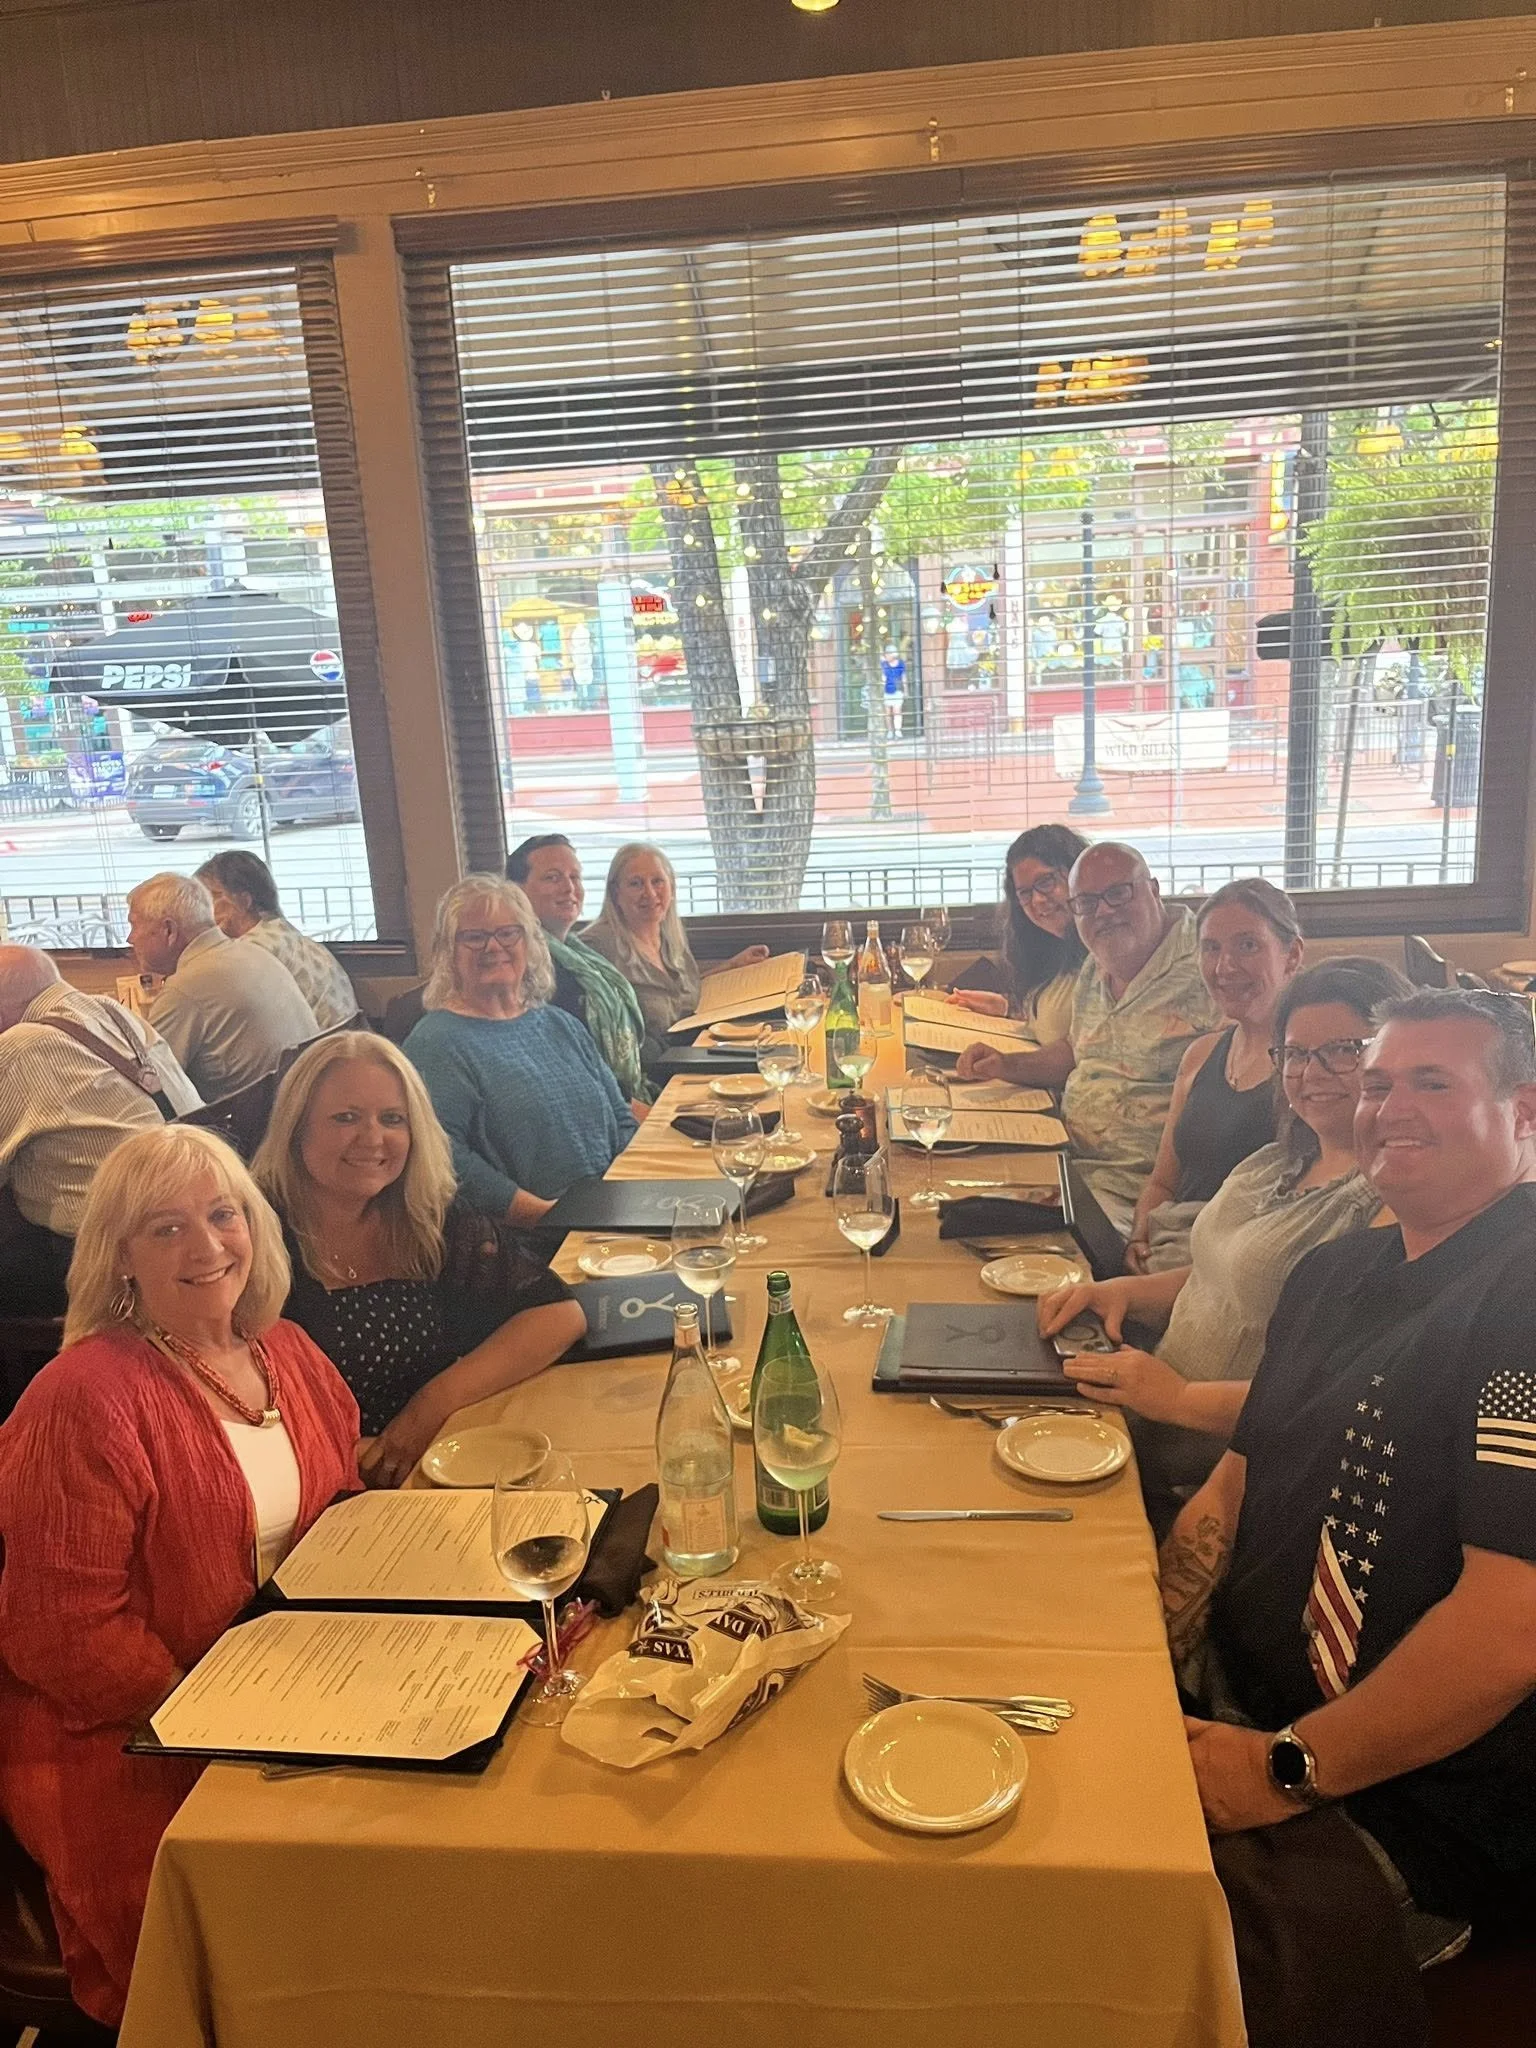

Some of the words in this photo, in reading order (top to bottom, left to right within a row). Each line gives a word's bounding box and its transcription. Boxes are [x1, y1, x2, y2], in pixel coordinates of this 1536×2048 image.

[101, 663, 192, 690] PEPSI
[1105, 744, 1137, 757] WILD
[653, 1640, 689, 1659] XAS
